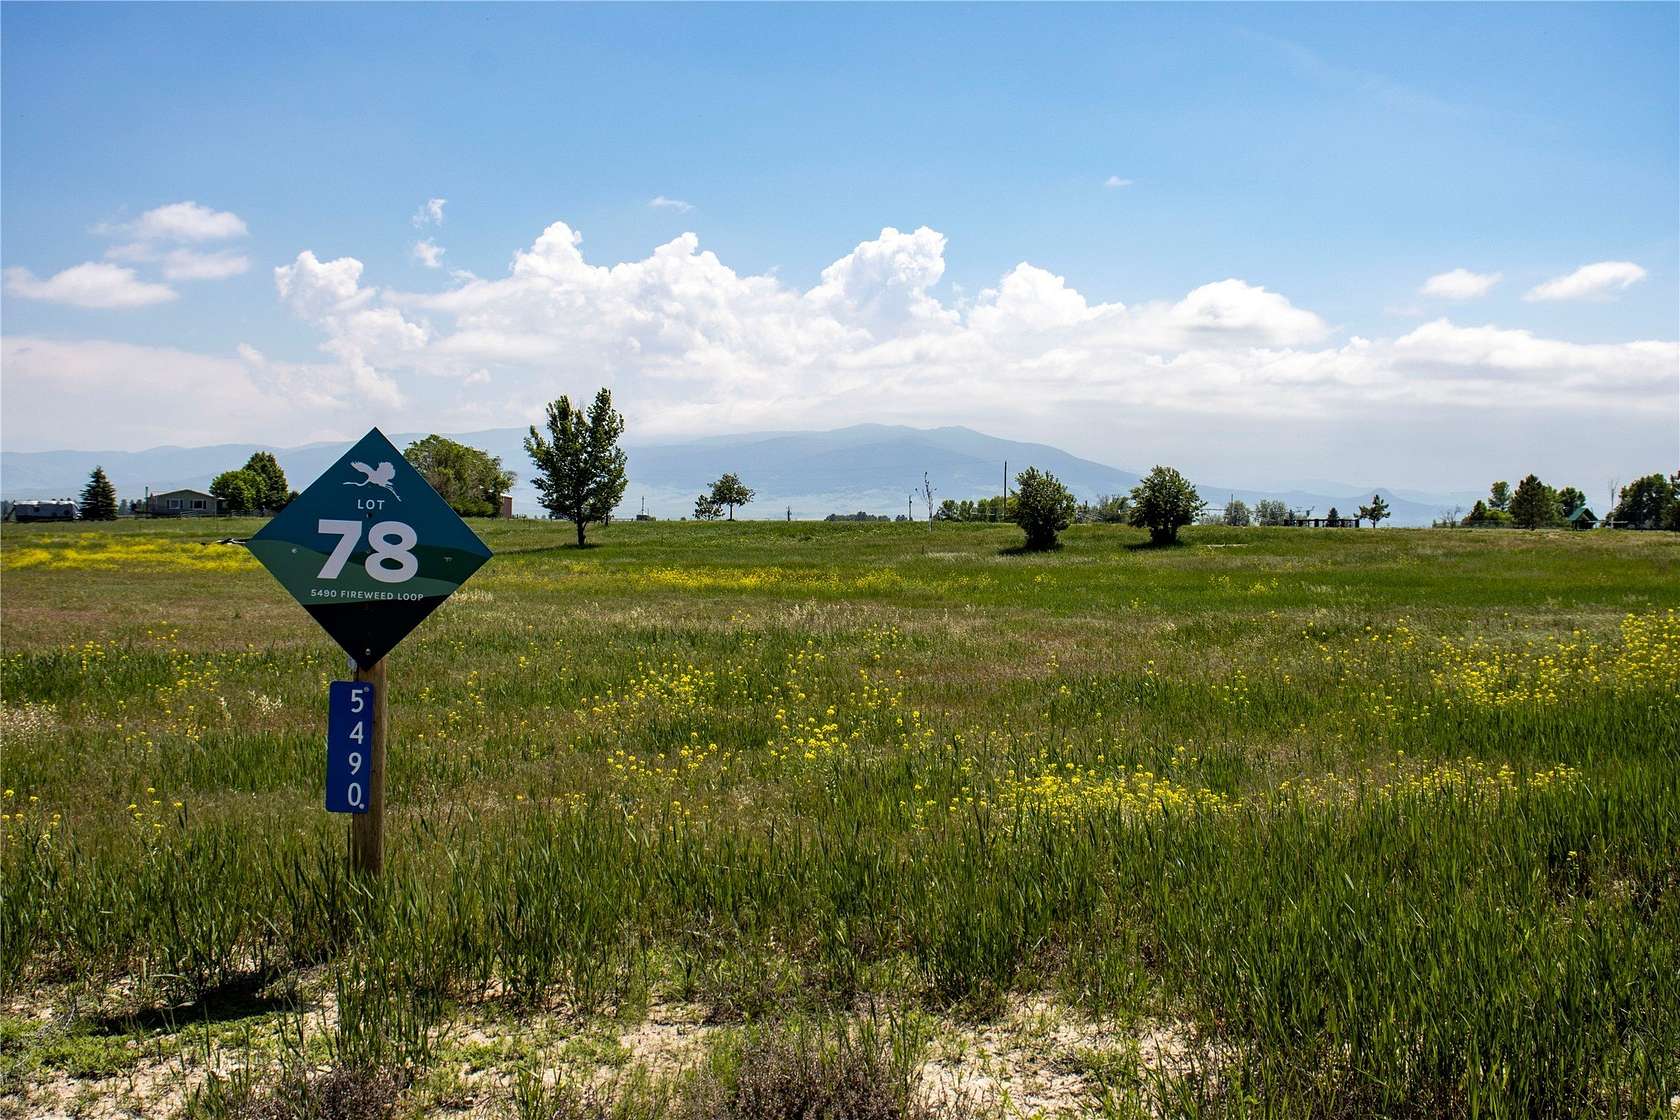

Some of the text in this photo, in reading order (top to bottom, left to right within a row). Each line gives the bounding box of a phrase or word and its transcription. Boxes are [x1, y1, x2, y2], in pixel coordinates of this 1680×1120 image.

[357, 499, 385, 510] LOT
[316, 518, 419, 583] 78
[310, 588, 424, 601] 5490 FIREWEED LOOP
[347, 689, 364, 807] 5490
